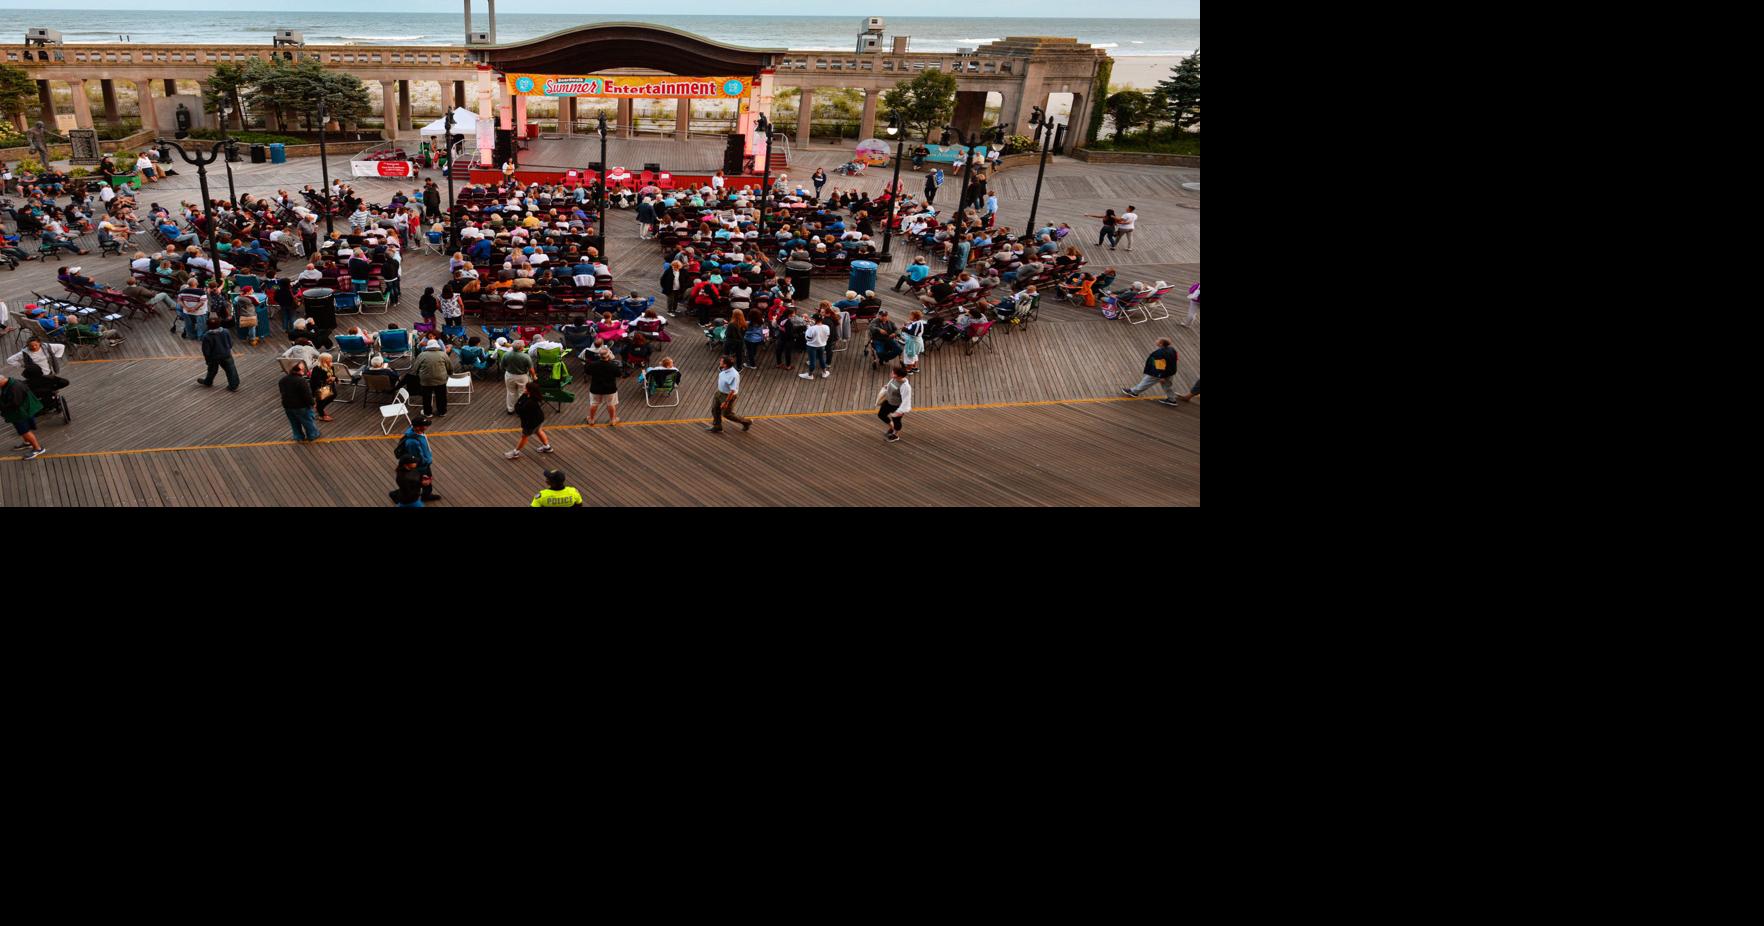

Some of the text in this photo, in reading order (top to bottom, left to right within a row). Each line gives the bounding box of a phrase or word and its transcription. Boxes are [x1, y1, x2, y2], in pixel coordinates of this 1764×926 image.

[546, 79, 598, 93] Summer
[604, 80, 717, 95] Entertainment
[547, 496, 573, 504] POLICE
